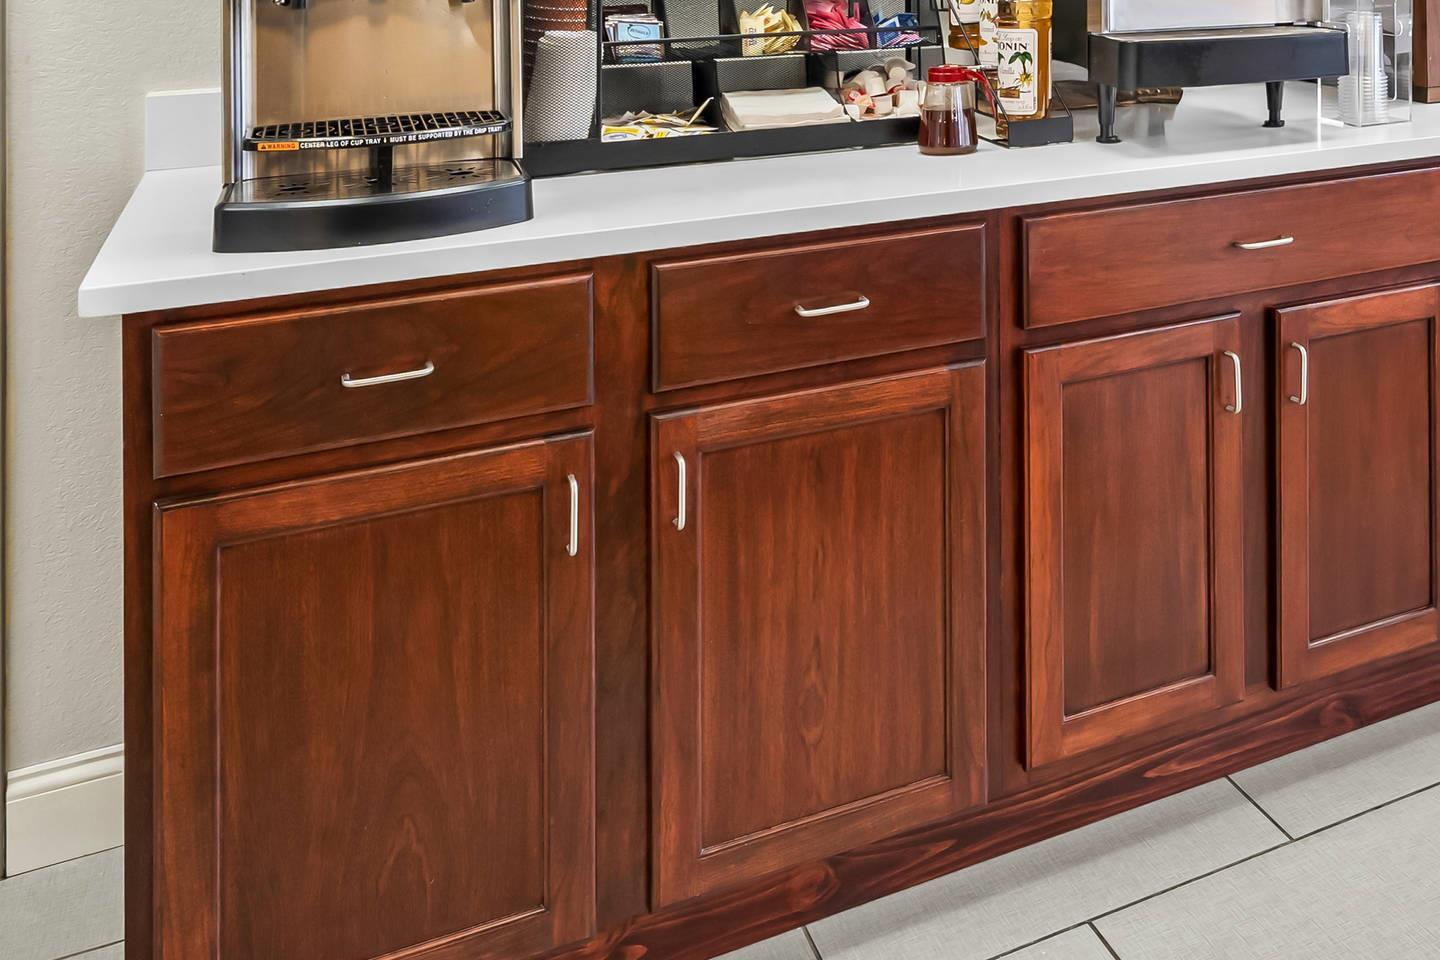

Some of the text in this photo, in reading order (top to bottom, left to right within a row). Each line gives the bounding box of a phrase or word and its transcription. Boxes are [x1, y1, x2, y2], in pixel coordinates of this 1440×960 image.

[998, 42, 1028, 51] ONIN
[300, 141, 325, 149] CENTER
[365, 138, 381, 146] TRAY
[418, 130, 453, 140] SUPPORTED
